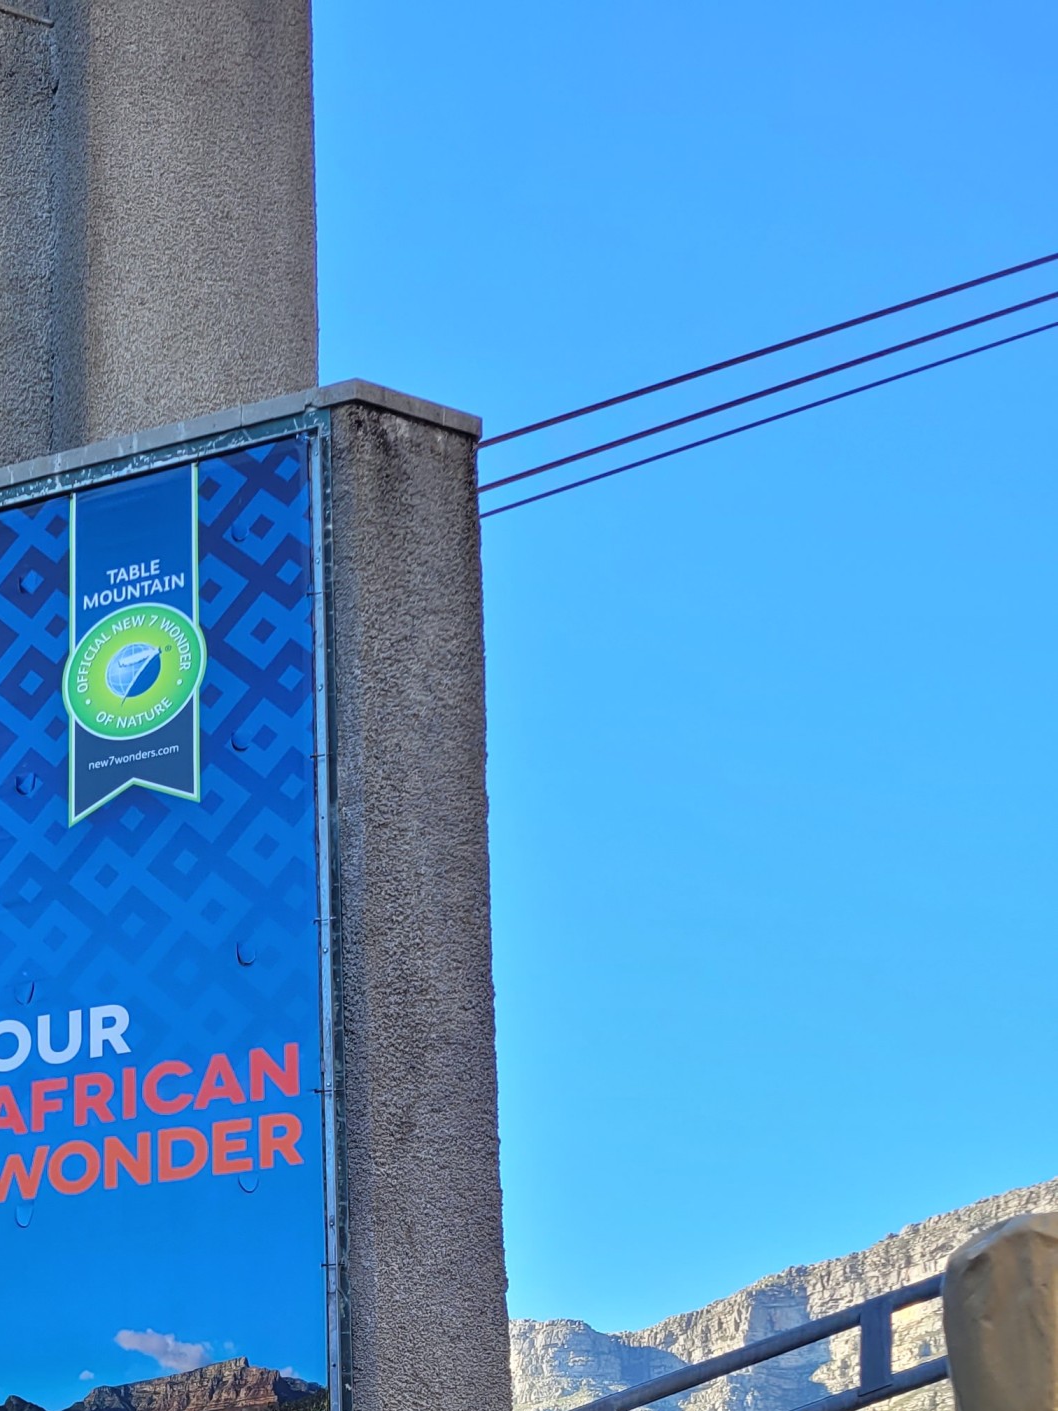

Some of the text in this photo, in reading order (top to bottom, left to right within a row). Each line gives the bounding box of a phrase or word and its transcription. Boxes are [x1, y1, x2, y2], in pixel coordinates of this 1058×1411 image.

[106, 559, 160, 585] TABLE
[83, 573, 185, 610] MOUNTAIN
[76, 614, 192, 693] OFFICIAL NEW 7 WONDER
[95, 696, 173, 729] OF NATURE
[88, 744, 180, 771] new7wonders.com
